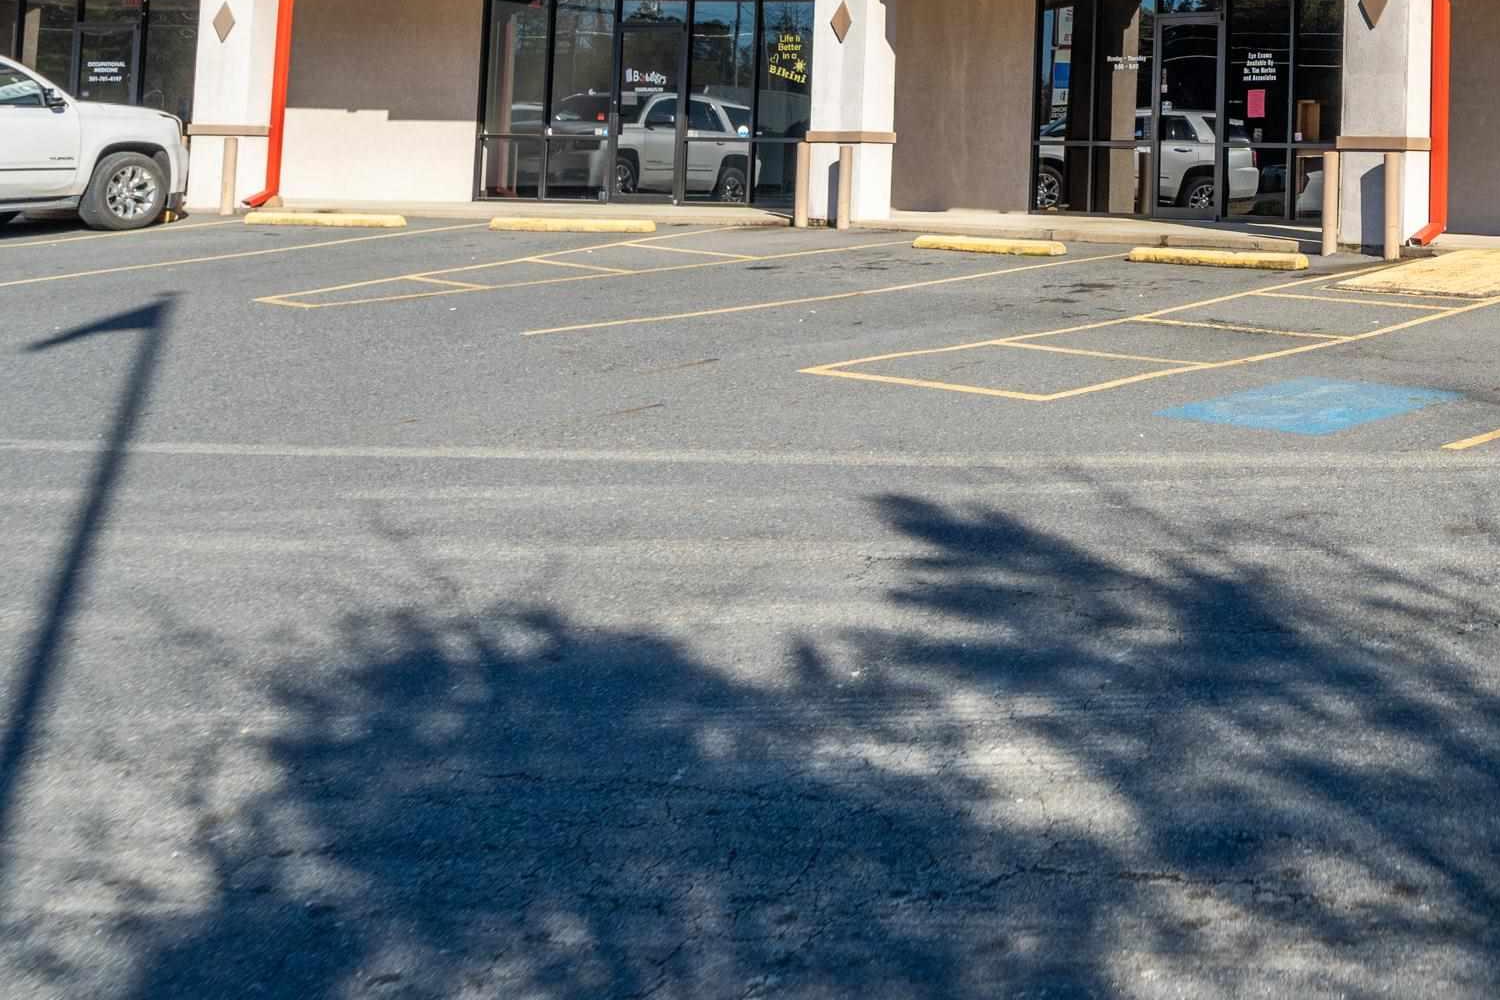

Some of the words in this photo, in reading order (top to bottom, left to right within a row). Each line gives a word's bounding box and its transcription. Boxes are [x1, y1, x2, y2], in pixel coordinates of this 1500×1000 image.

[779, 34, 794, 43] Life
[777, 43, 802, 51] Better
[1247, 52, 1257, 60] Eye
[768, 64, 808, 84] Bikini
